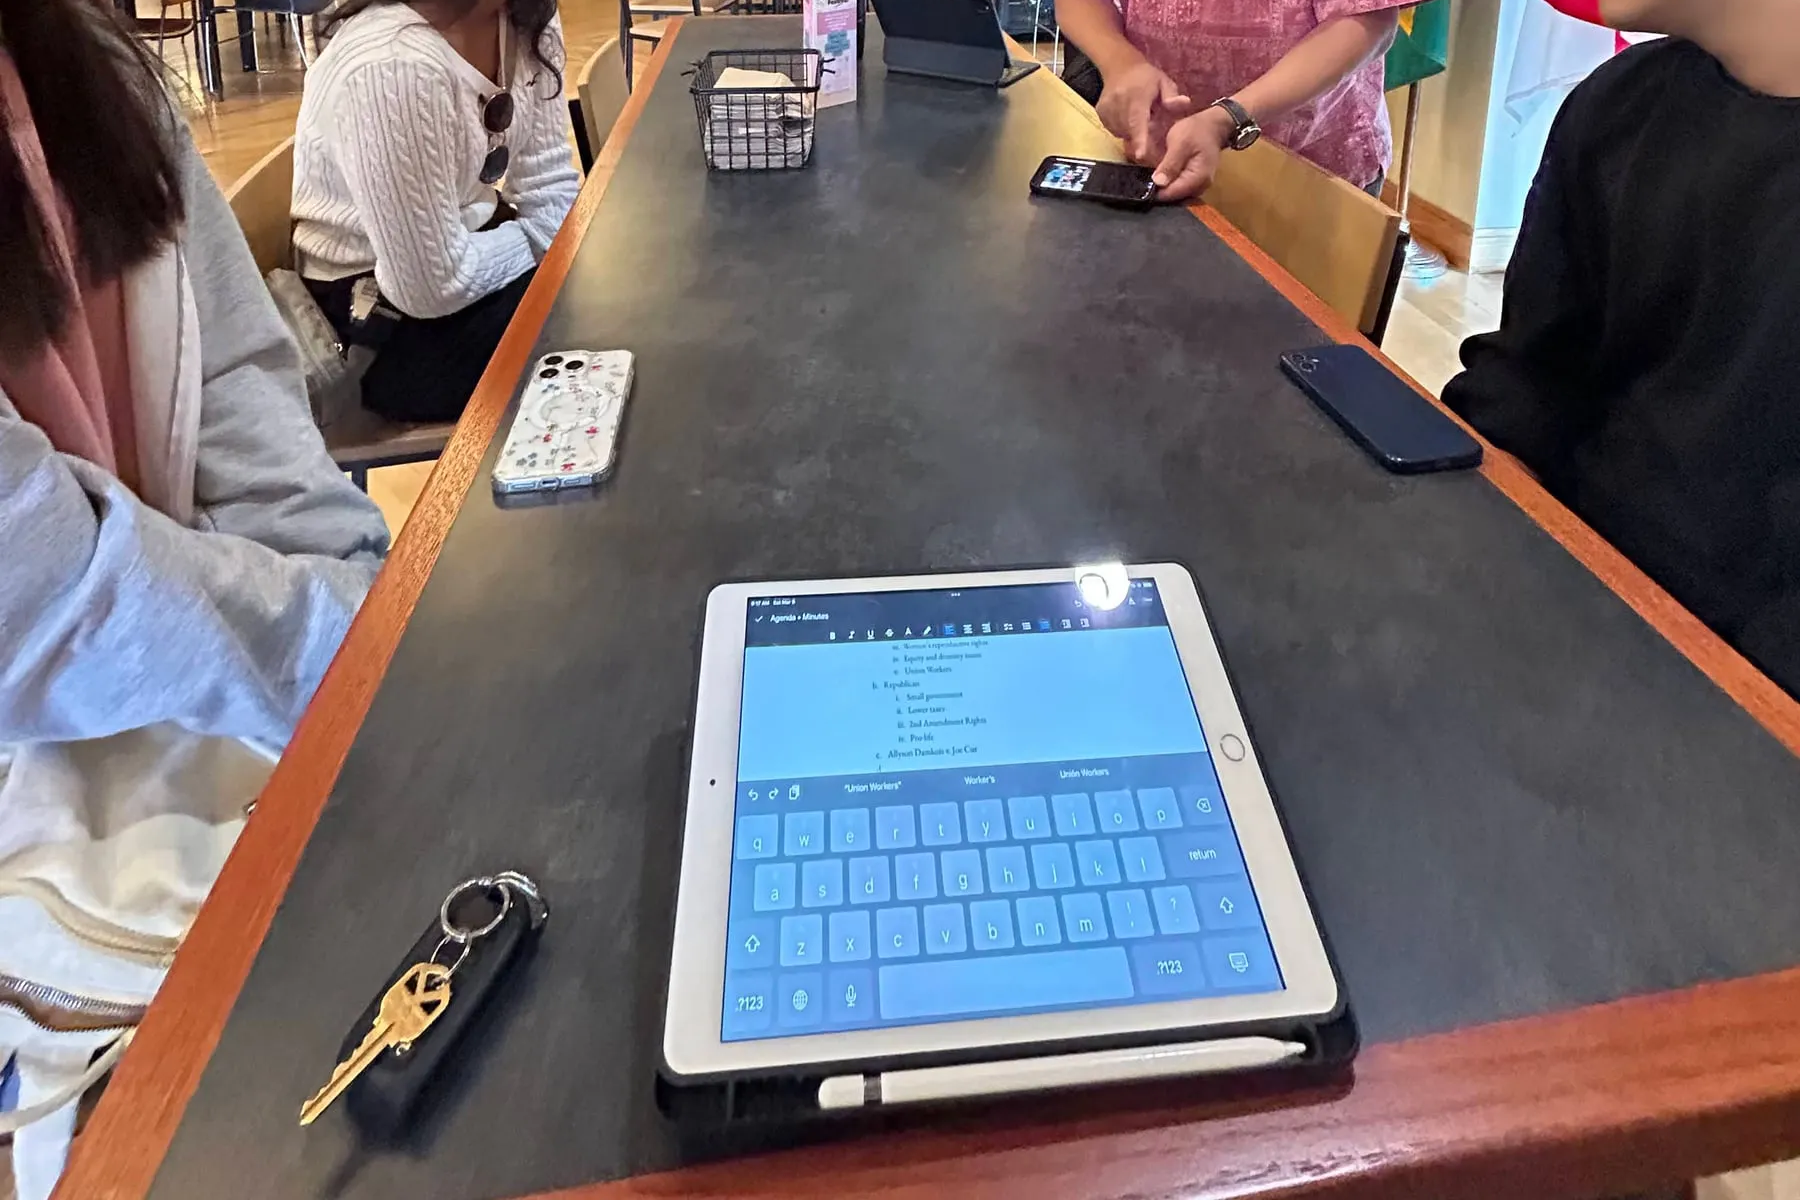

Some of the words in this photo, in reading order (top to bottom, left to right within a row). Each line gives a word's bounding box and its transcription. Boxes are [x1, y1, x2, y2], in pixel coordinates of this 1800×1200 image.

[770, 614, 796, 624] Agenda
[802, 612, 829, 620] Minutes
[904, 666, 926, 675] Union
[926, 666, 952, 674] Workers
[884, 680, 920, 690] Republican
[906, 692, 924, 701] Small
[908, 706, 928, 714] Lower
[965, 716, 987, 726] Rights
[952, 746, 963, 756] Joe
[1080, 768, 1110, 777] Workers
[964, 775, 996, 785] Worker's
[753, 838, 762, 852] q
[800, 834, 810, 846] w
[846, 832, 854, 843] e
[893, 828, 899, 840] r
[938, 823, 944, 836] t
[982, 821, 989, 836] y
[1026, 818, 1035, 830] u
[1114, 812, 1122, 824] o
[1156, 810, 1166, 824] p
[770, 888, 779, 900] a
[818, 884, 826, 898] s
[864, 876, 874, 894] d
[914, 874, 919, 890] f
[958, 874, 968, 890] g
[1003, 866, 1014, 884] h
[1094, 860, 1104, 876] k
[1188, 848, 1217, 861] return
[797, 942, 805, 956] z
[846, 938, 854, 952] x
[894, 934, 902, 948] c
[941, 930, 950, 944] v
[988, 923, 998, 940] b
[1035, 922, 1044, 936] n
[1080, 918, 1093, 932] m
[735, 996, 764, 1012] .?123
[1157, 960, 1182, 975] .?123
